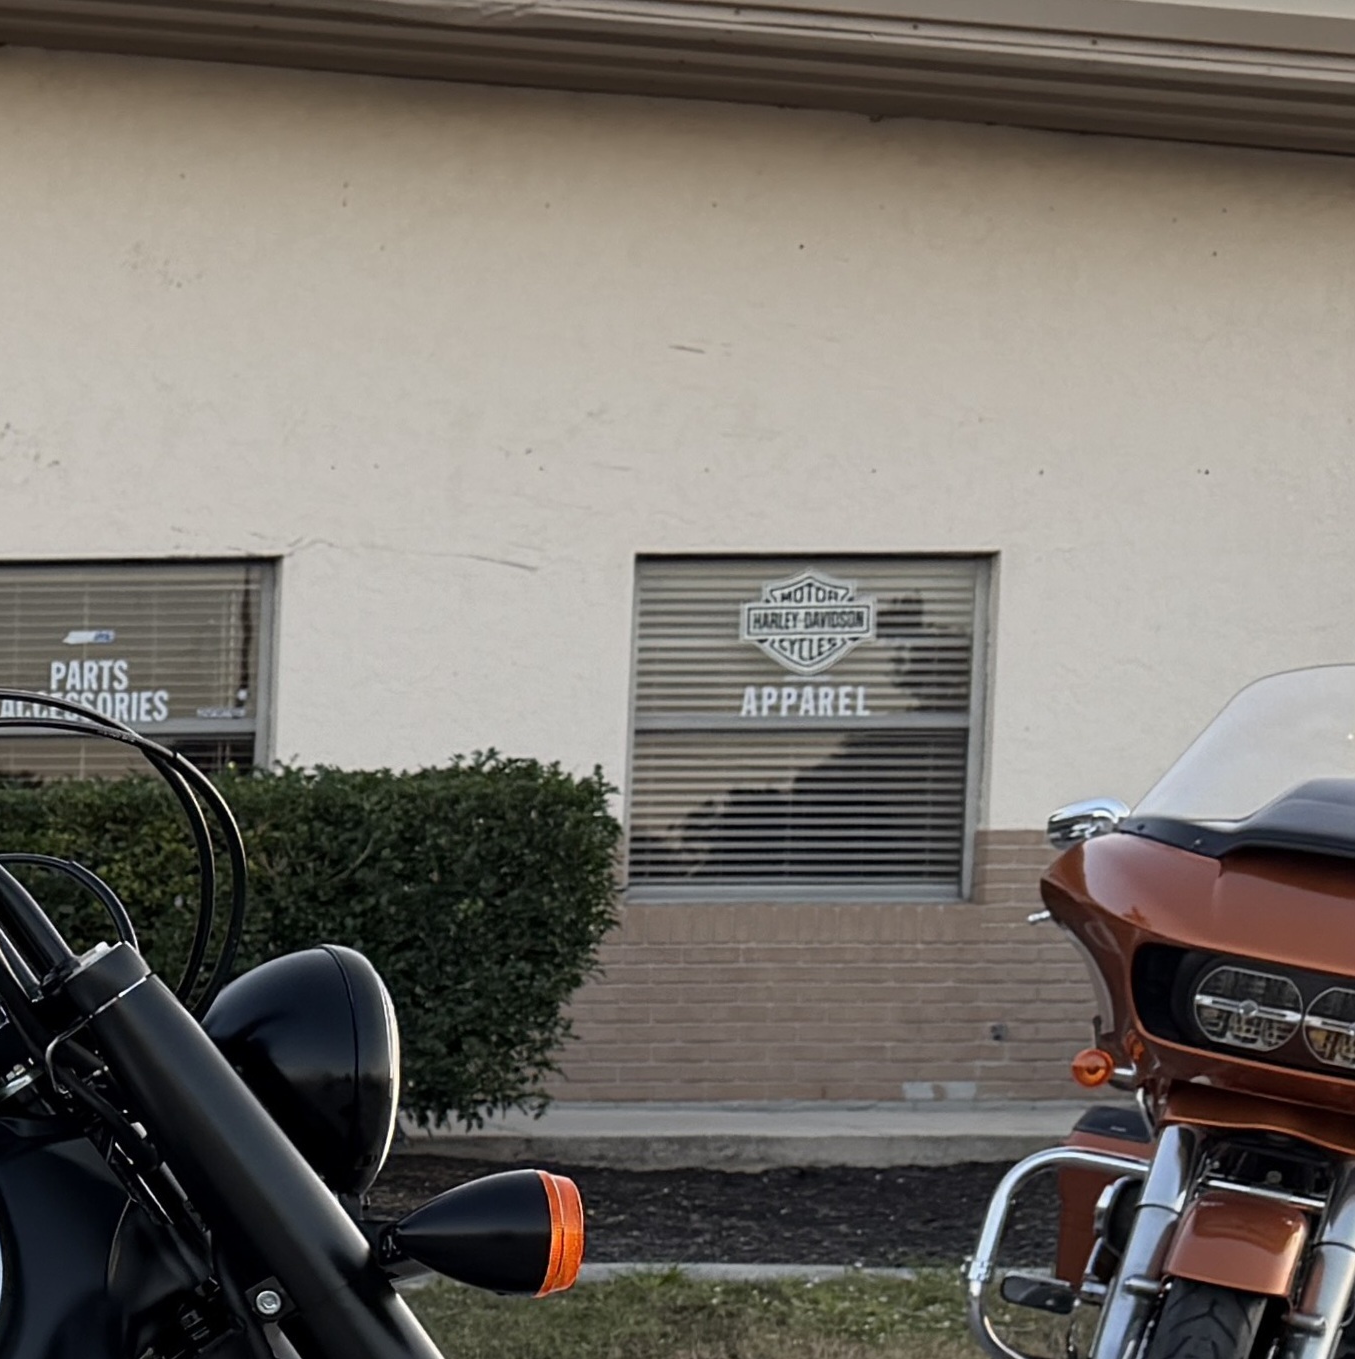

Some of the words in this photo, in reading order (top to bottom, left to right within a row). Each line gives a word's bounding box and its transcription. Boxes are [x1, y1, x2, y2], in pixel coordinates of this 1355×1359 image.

[780, 582, 839, 603] MOTOR
[778, 636, 838, 662] CYCLES
[50, 660, 130, 691] PARTS
[740, 686, 871, 717] APPAREL
